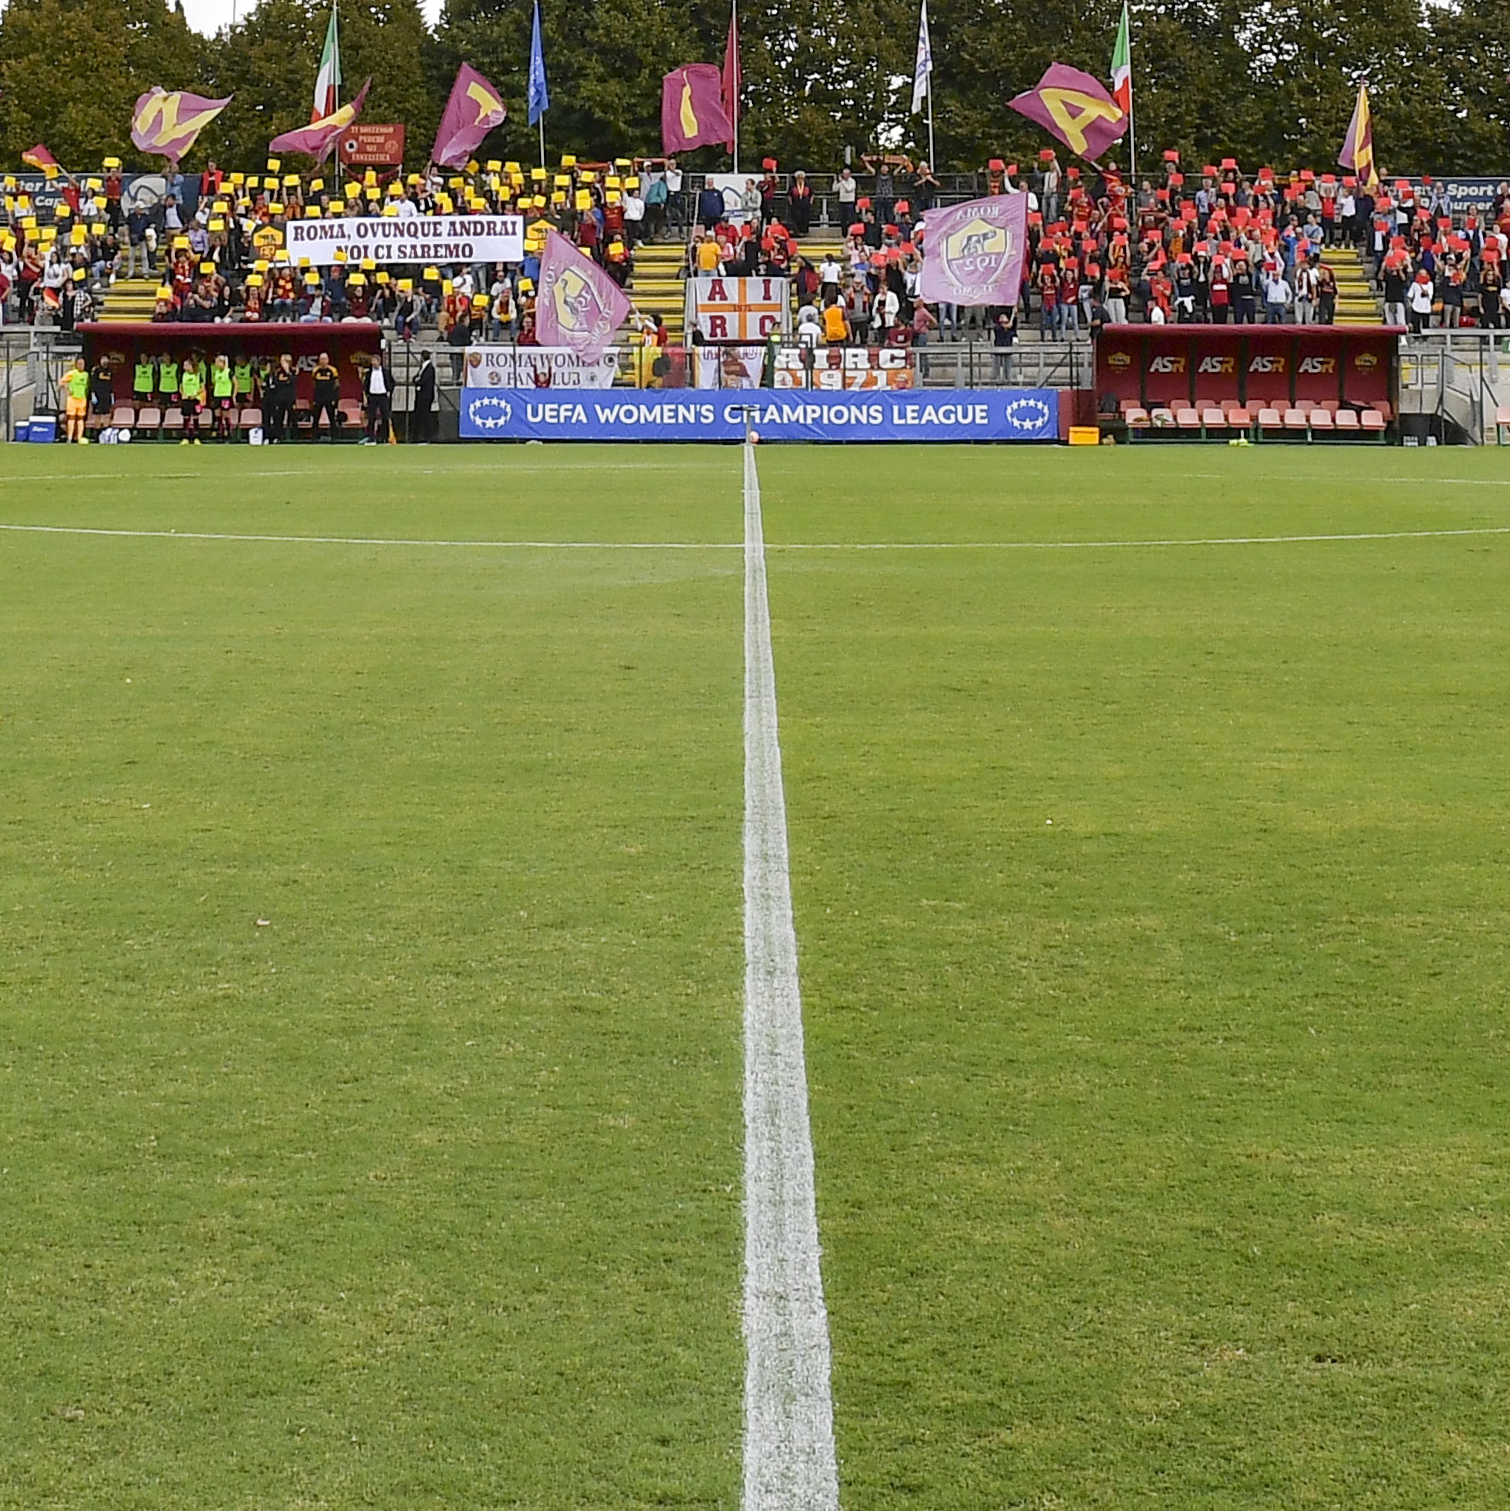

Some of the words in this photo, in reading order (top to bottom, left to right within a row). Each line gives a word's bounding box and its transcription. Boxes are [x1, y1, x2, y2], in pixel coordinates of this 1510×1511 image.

[1039, 88, 1123, 155] A
[293, 222, 351, 241] ROMA,
[356, 221, 442, 240] OVUNQUE
[447, 220, 518, 238] ANDRAI
[374, 244, 392, 259] CI
[397, 242, 474, 259] SAREMO
[708, 279, 728, 301] A
[762, 279, 772, 301] I
[709, 315, 728, 337] R
[759, 315, 776, 337] C
[485, 353, 534, 368] ROMA
[536, 353, 600, 368] WOM
[1149, 356, 1186, 373] ASR
[1198, 356, 1235, 373] ASR
[1249, 356, 1285, 373] ASR
[1298, 357, 1336, 373] ASR
[552, 372, 581, 386] LUB
[526, 403, 588, 423] UEFA
[594, 403, 715, 425] WOMEN'S
[724, 404, 883, 426] CHAMPIONS
[892, 404, 989, 425] LEAGUE
